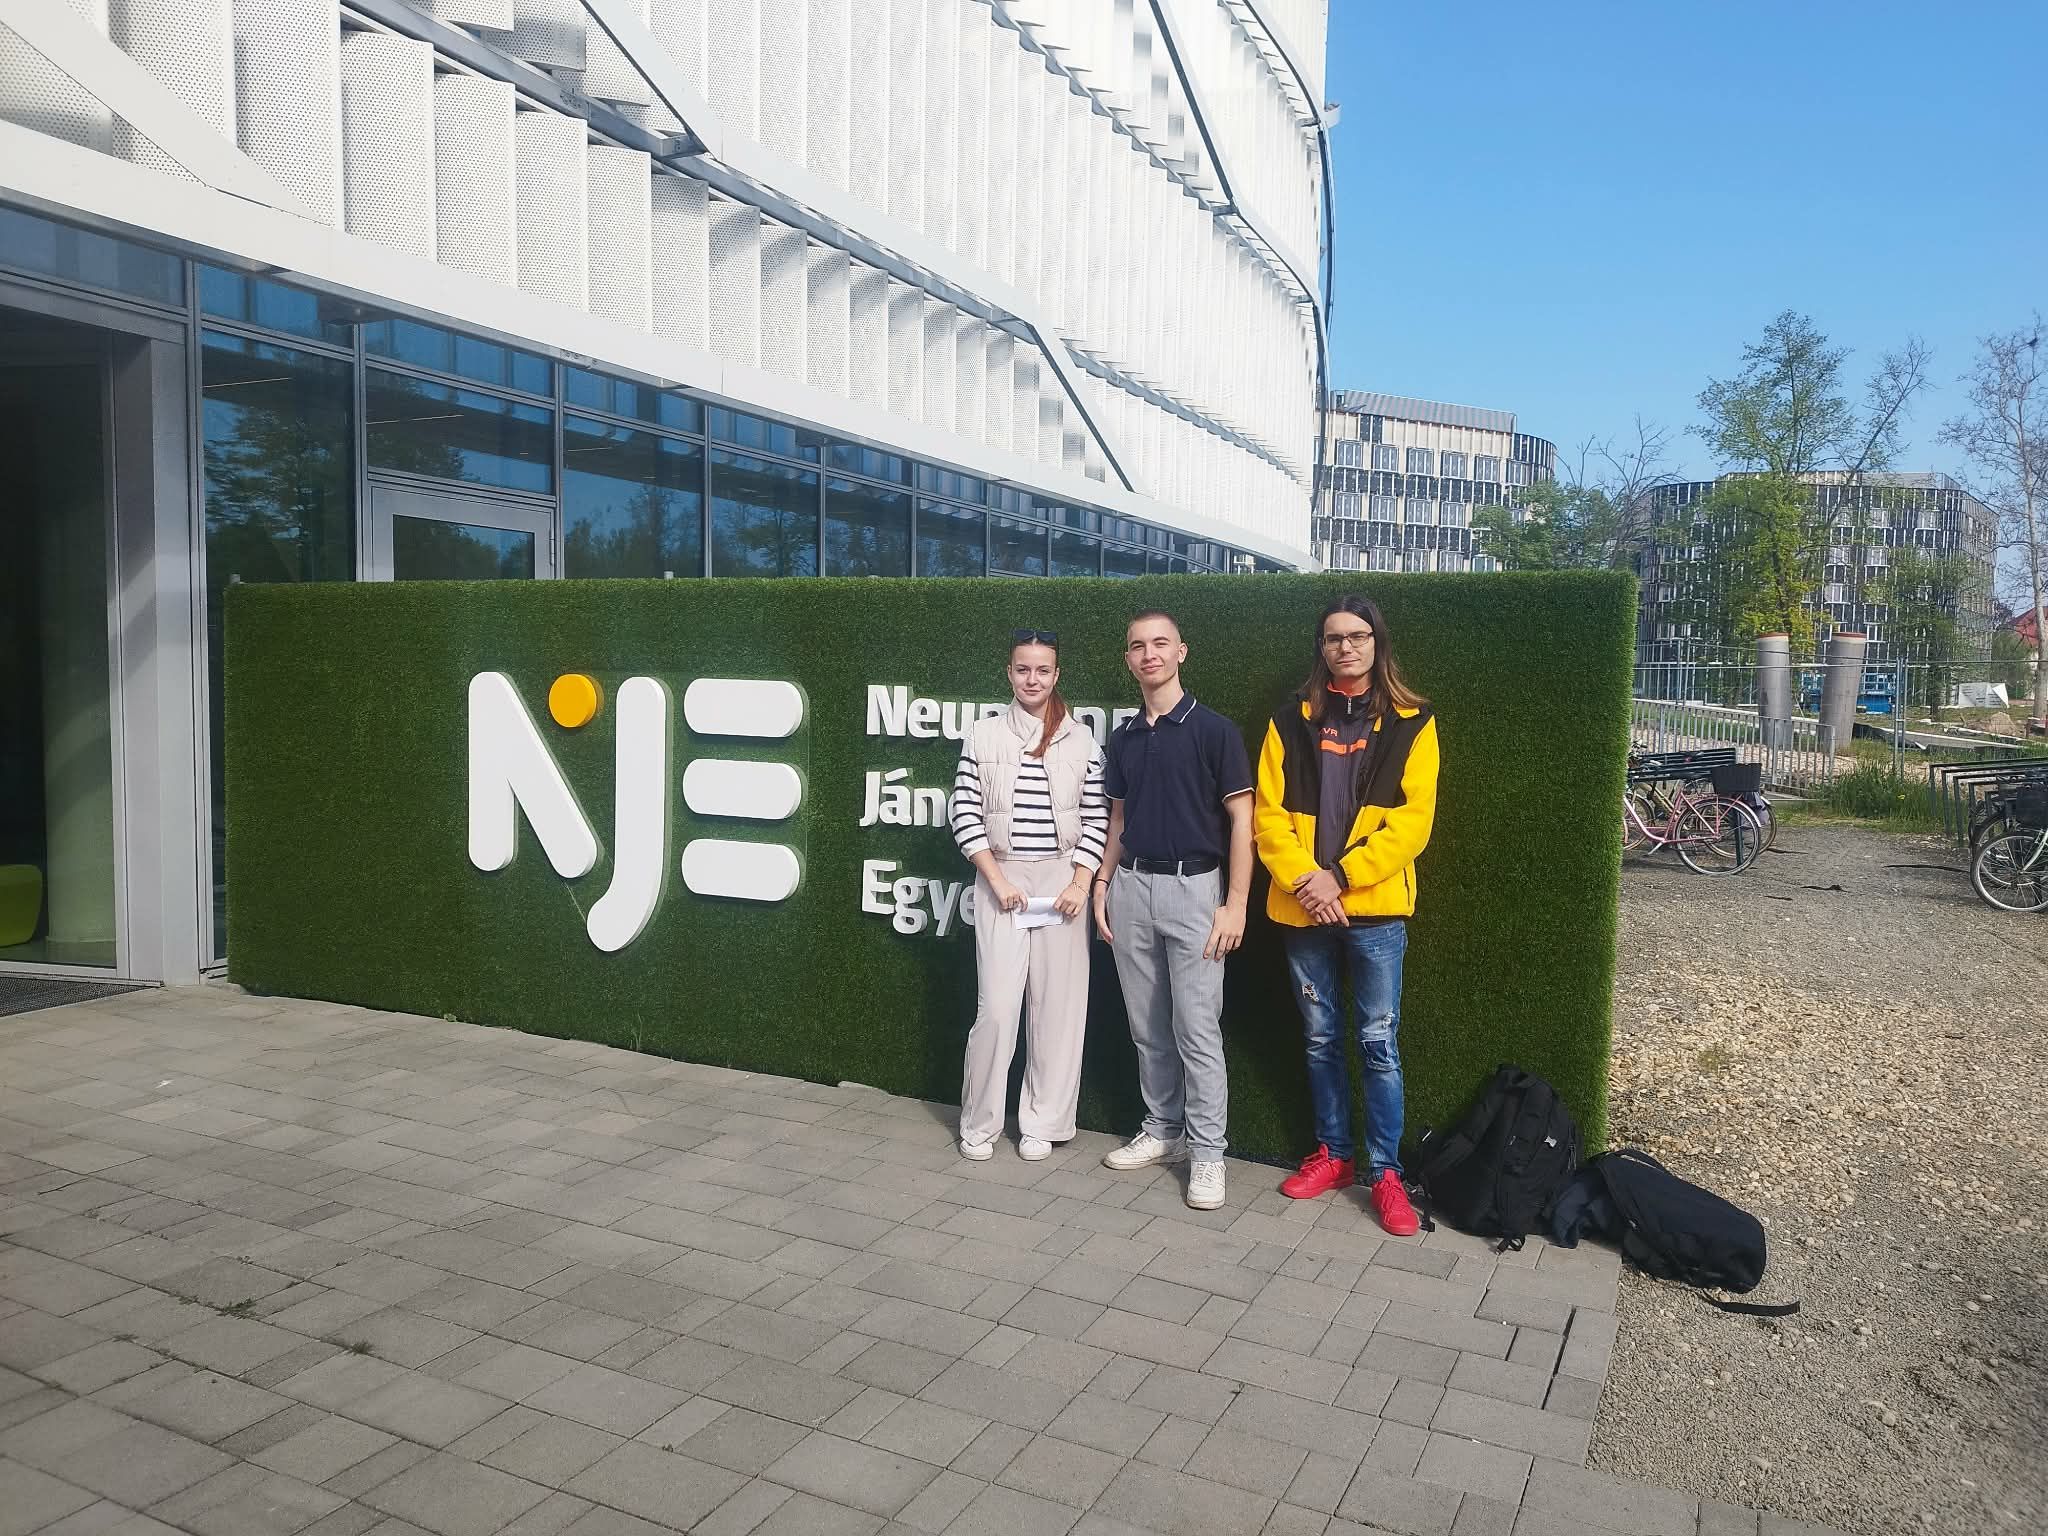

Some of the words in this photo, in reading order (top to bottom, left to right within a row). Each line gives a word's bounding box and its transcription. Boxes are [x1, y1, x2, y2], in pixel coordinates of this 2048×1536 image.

[468, 671, 804, 952] NJE
[859, 767, 956, 828] Ján
[862, 859, 976, 937] Egye
